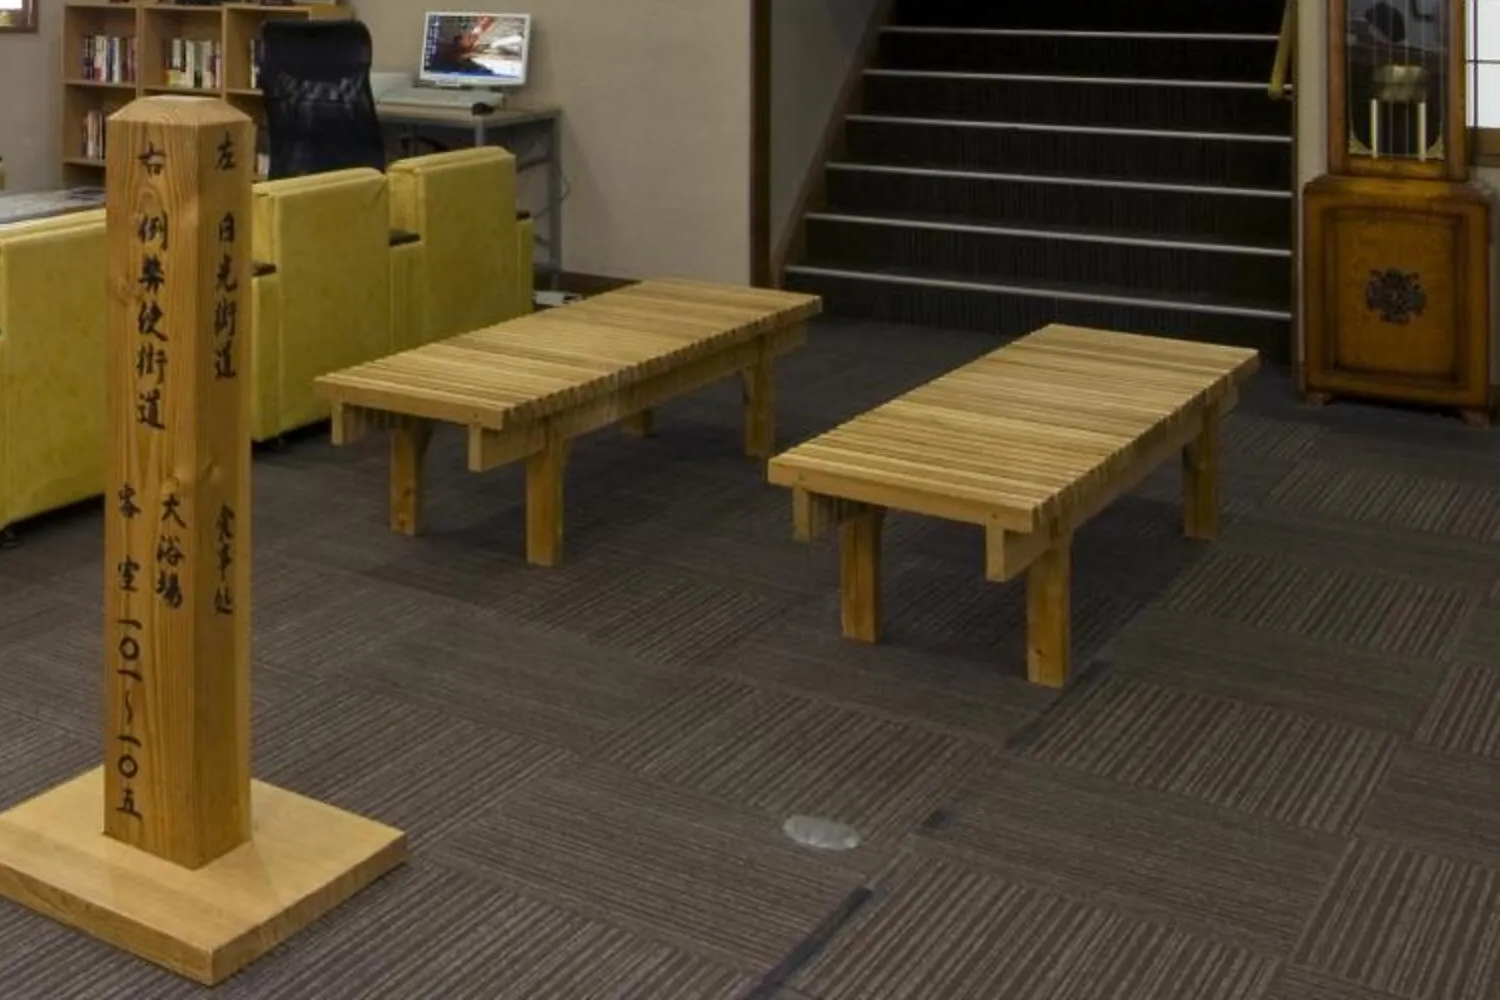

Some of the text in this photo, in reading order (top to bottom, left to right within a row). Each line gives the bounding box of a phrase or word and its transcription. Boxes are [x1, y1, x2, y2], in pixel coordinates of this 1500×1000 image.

[137, 141, 167, 177] 右
[214, 131, 238, 172] 左
[155, 493, 188, 610] 大浴場
